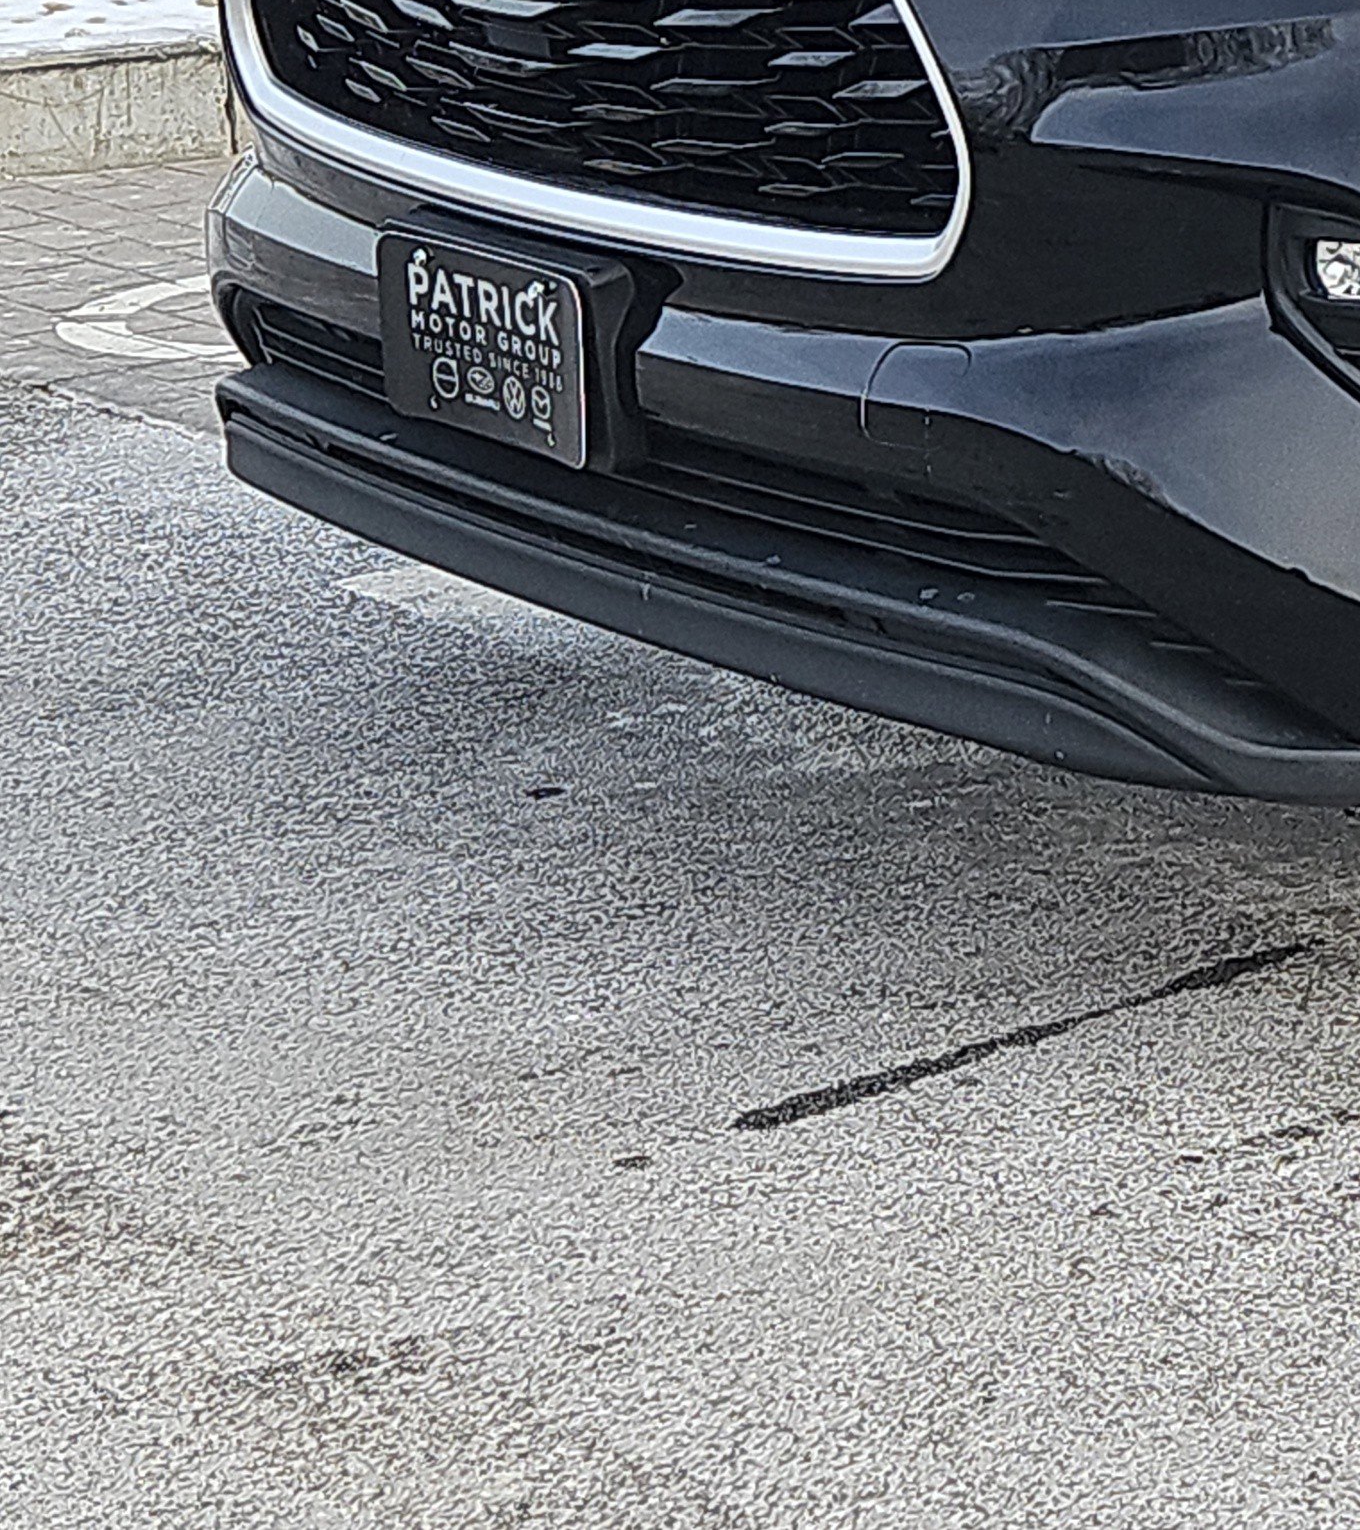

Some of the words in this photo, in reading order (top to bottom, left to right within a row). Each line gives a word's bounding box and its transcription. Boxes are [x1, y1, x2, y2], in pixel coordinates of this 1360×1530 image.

[407, 262, 560, 346] PATRICK
[411, 309, 487, 346] MOTOR
[497, 331, 561, 369] GROUP
[412, 333, 482, 363] TRUSTED
